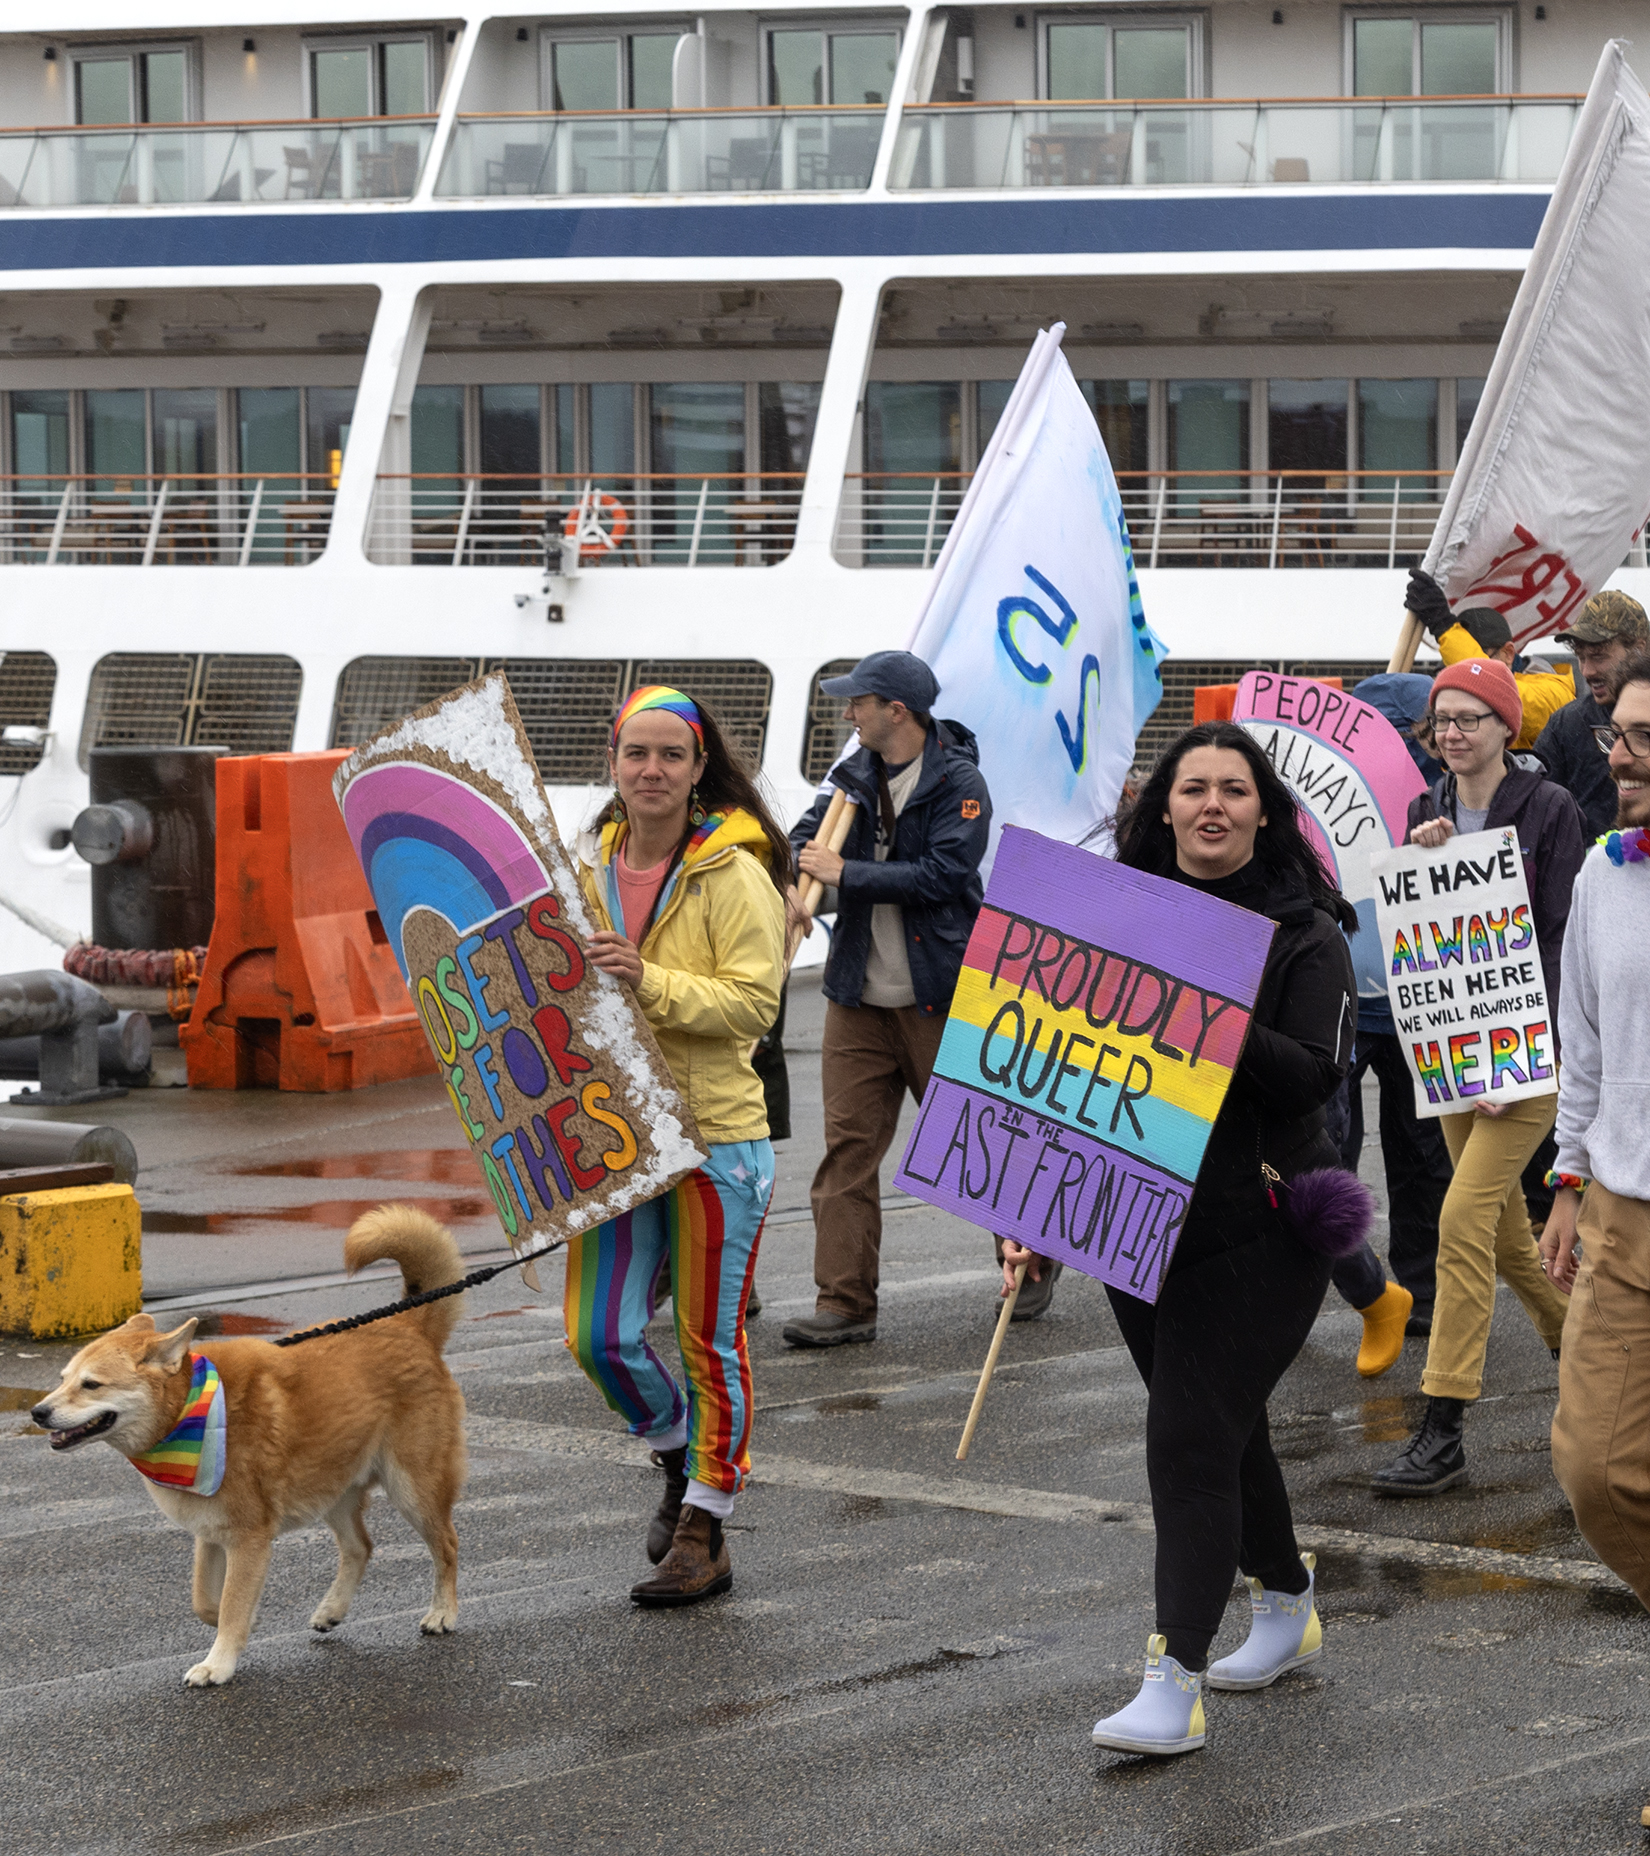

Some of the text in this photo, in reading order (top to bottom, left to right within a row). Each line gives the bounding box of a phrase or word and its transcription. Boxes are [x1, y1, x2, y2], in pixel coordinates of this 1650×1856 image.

[1251, 674, 1374, 753] PEOPLE
[1264, 729, 1376, 848] ALWAYS
[1378, 848, 1518, 906] WE HAVE
[416, 895, 586, 1066] OSETS
[1390, 905, 1534, 977] ALWAYS
[1397, 961, 1536, 1010] BEEN HERE
[988, 917, 1239, 1068] PROUDLY
[1398, 992, 1545, 1035] WE WILL ALWAYS BE
[473, 1004, 594, 1122] FOR
[978, 1000, 1153, 1141] QUEER
[1411, 1020, 1554, 1105] HERE
[482, 1080, 640, 1238] OTHES
[1001, 1105, 1064, 1145] IN THE
[903, 1083, 1189, 1293] LAST FRONTIER
